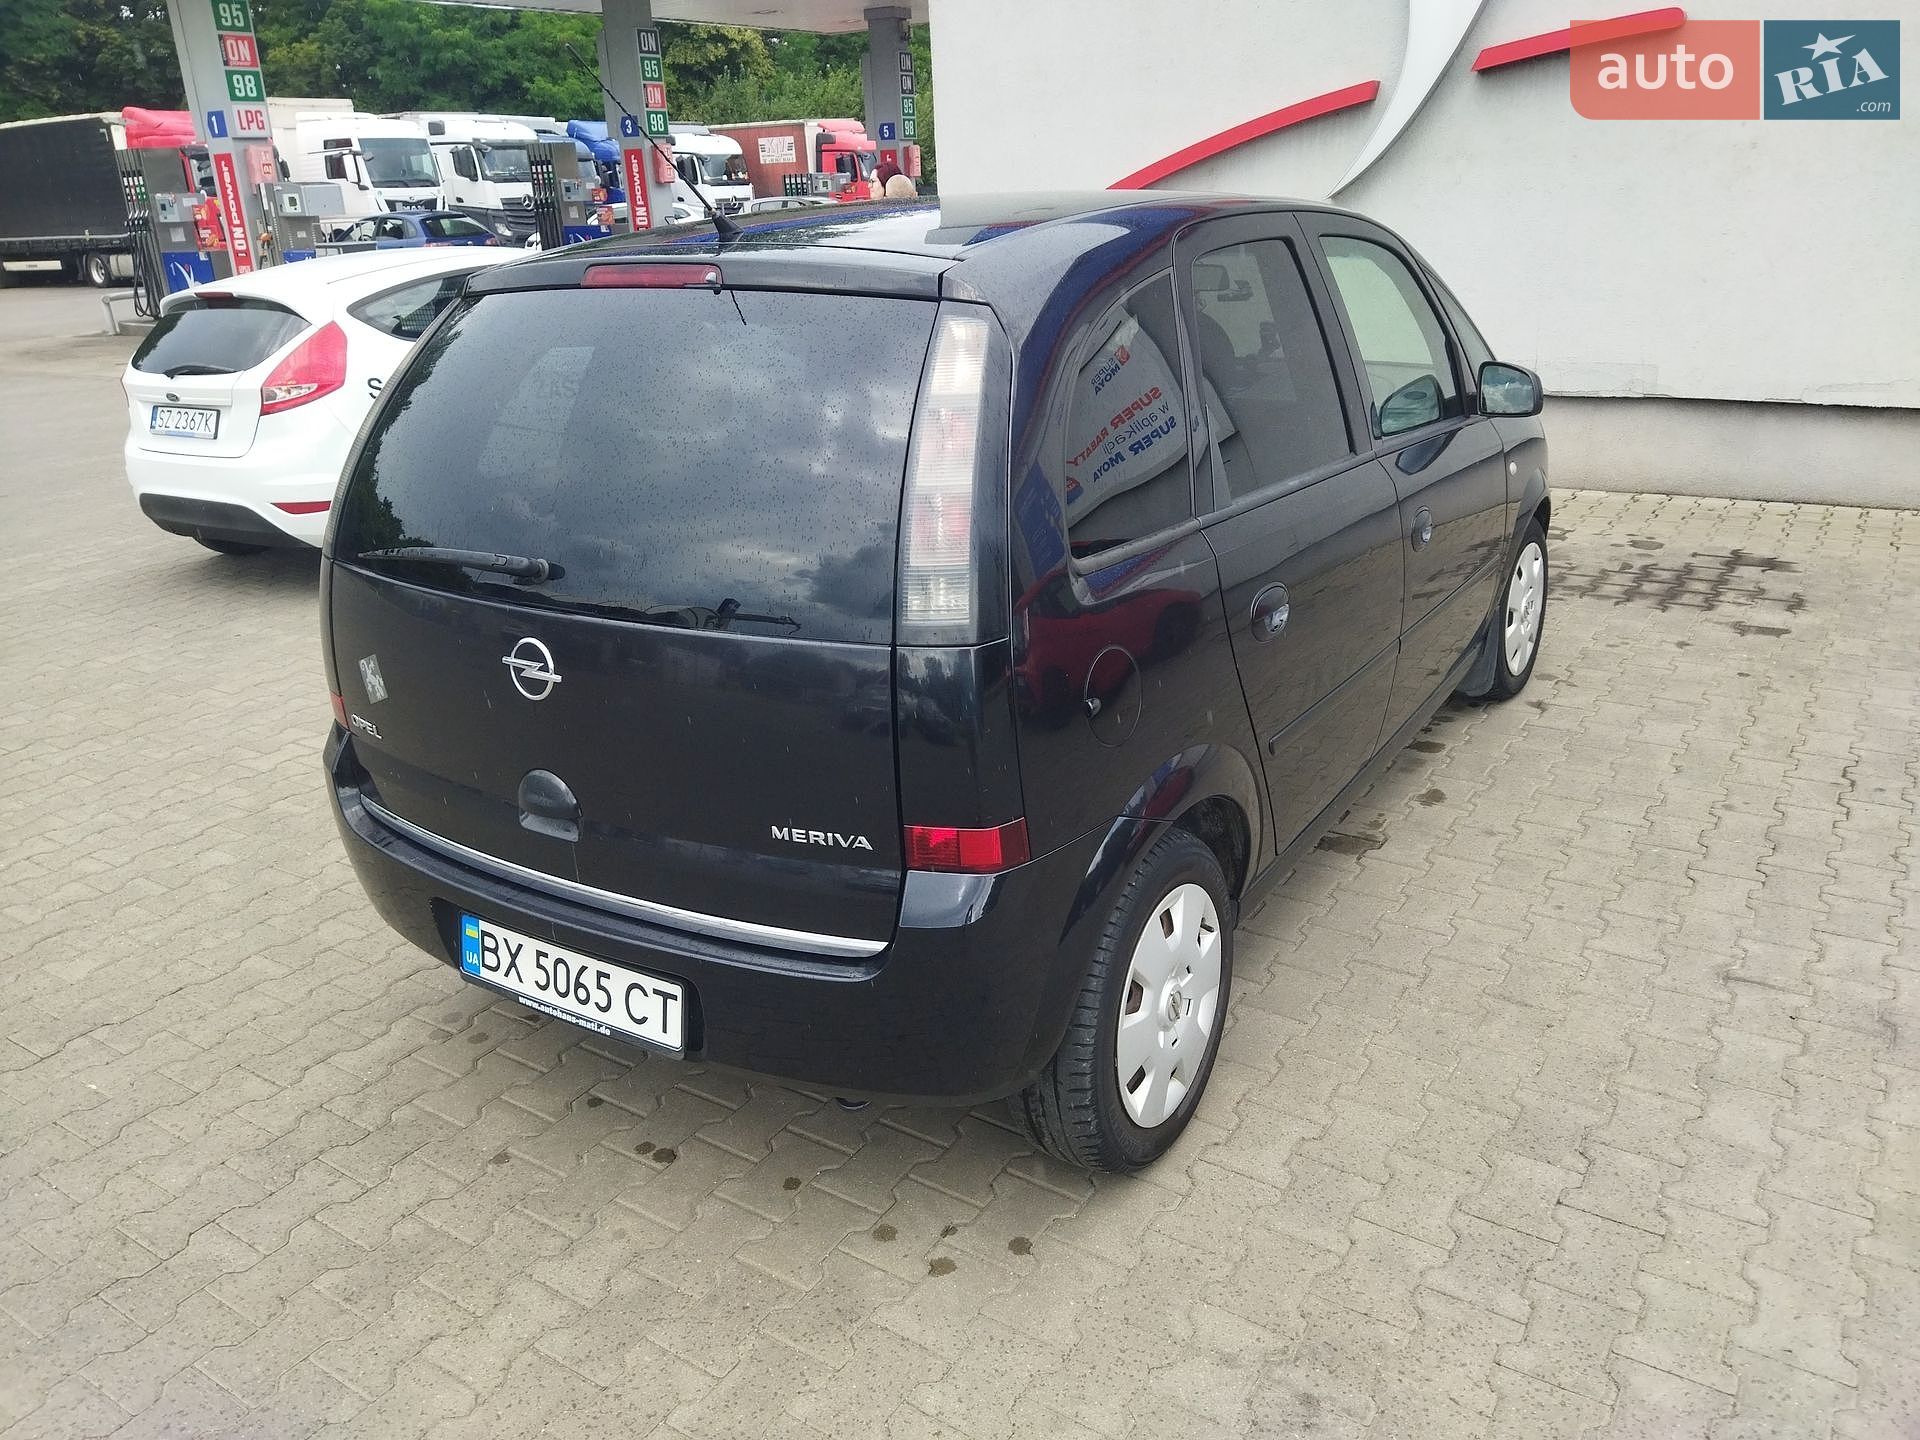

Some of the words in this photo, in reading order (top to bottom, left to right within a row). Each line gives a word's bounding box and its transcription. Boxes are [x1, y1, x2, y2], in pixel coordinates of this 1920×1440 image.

[219, 3, 245, 27] 95
[226, 39, 252, 62] ON
[640, 32, 656, 52] ON
[644, 60, 659, 78] 95
[900, 53, 912, 69] ON
[232, 74, 258, 98] 98
[902, 76, 913, 90] ON
[647, 87, 661, 104] ON
[903, 99, 914, 114] 95
[211, 115, 219, 134] 1
[237, 109, 266, 131] LPG
[625, 119, 633, 134] 3
[650, 113, 665, 132] 98
[904, 120, 915, 136] 98
[883, 124, 890, 138] 5
[158, 409, 173, 429] SZ
[174, 411, 213, 433] 2367K
[351, 714, 382, 740] OPEL
[771, 825, 874, 851] MERIVA
[465, 950, 480, 967] UA
[480, 929, 524, 985] BX
[534, 949, 613, 1014] 5065
[625, 982, 678, 1035] CT
